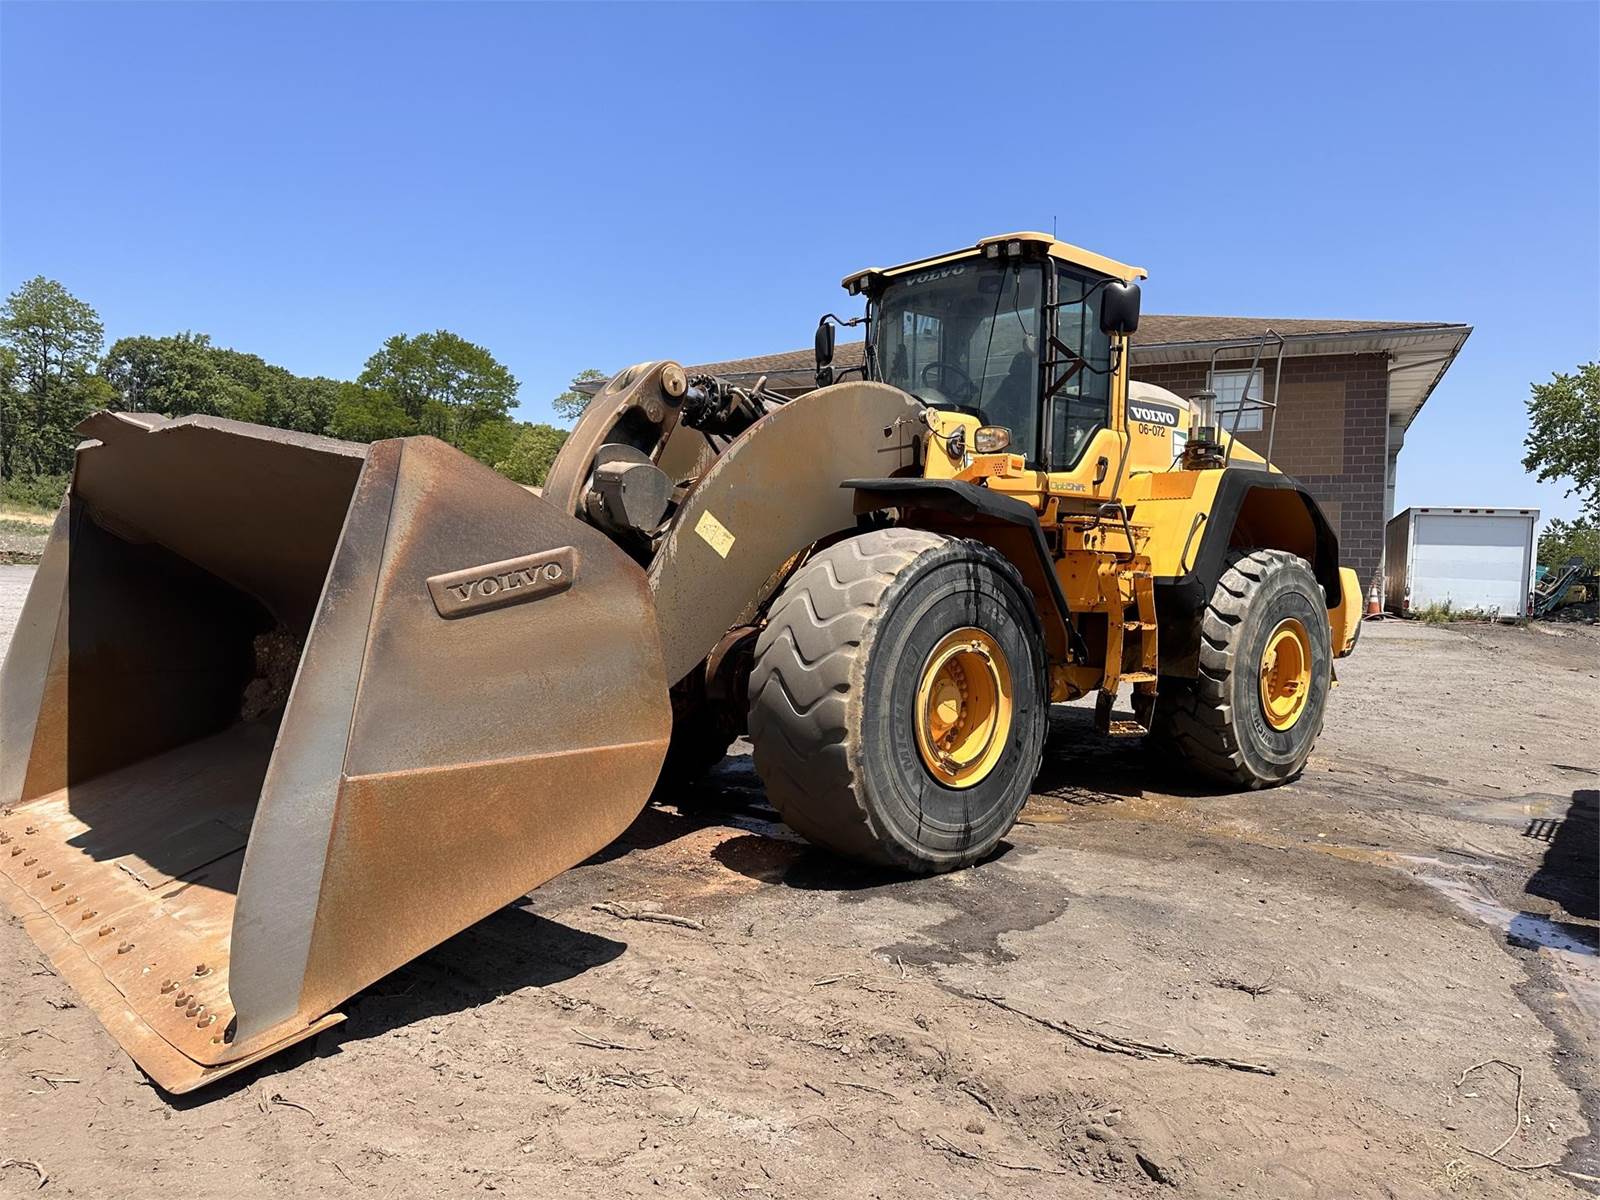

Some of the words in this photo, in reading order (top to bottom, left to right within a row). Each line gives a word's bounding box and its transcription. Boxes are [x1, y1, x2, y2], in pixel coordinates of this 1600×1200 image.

[906, 264, 965, 286] VOLVO
[1130, 406, 1175, 425] VOLVO
[1138, 422, 1166, 438] 06-072
[447, 561, 562, 602] VOLVO
